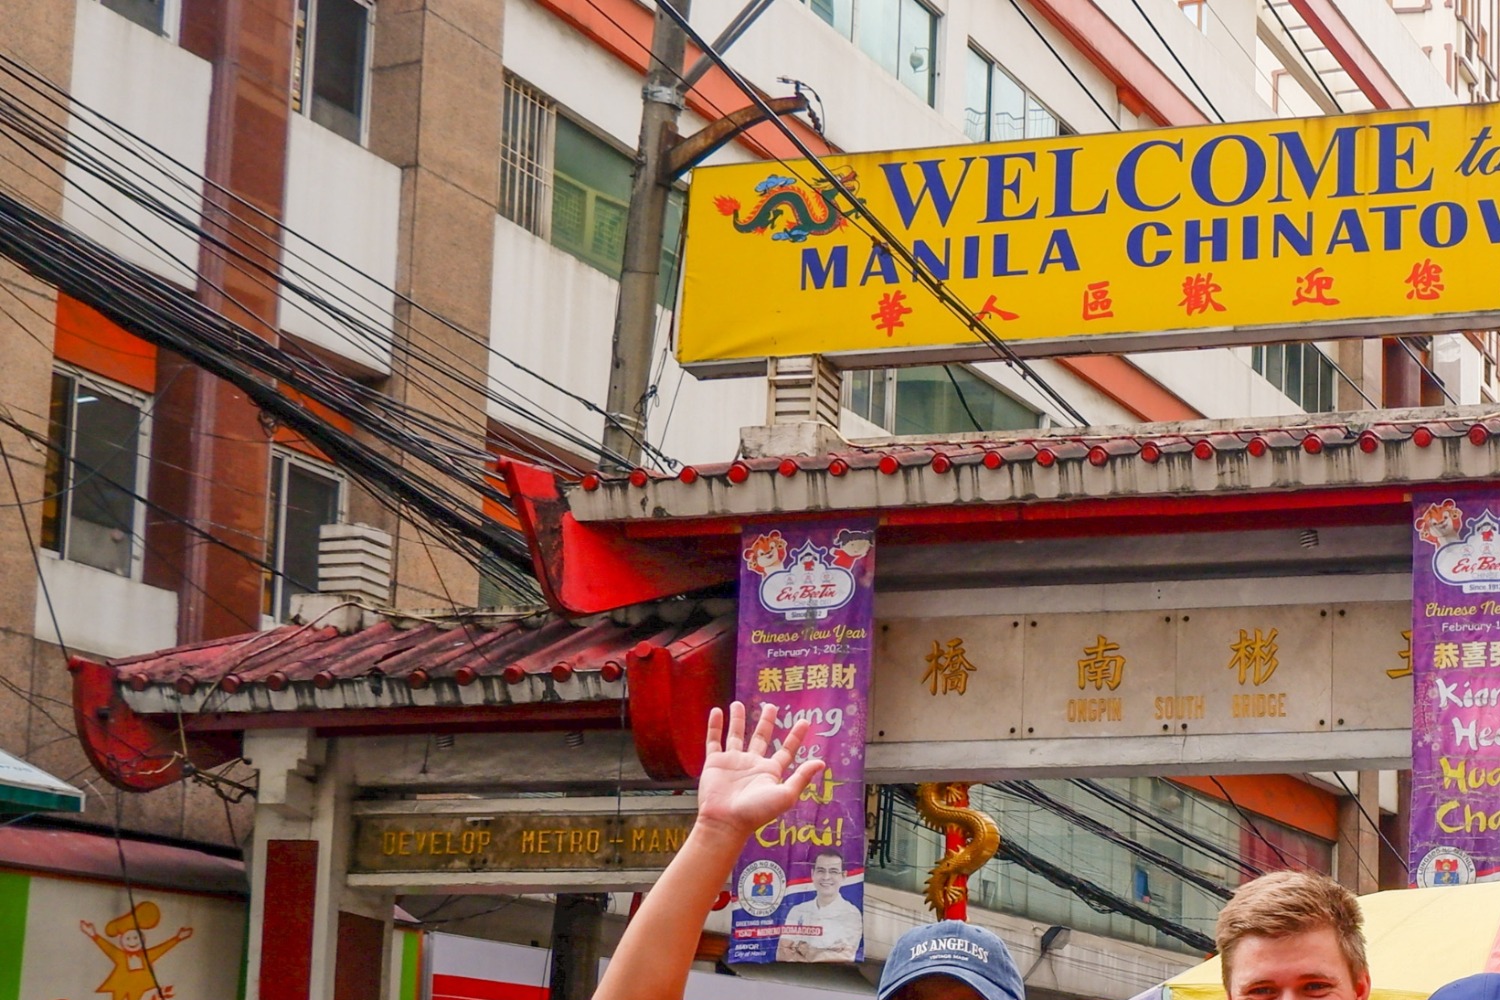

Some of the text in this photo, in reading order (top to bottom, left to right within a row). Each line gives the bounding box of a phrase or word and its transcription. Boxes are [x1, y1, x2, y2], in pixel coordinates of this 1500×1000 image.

[879, 120, 1435, 229] WELCOME
[799, 228, 1079, 291] MANILA
[1425, 602, 1478, 617] Chinese
[751, 629, 800, 644] Chinese
[832, 624, 867, 643] Year
[1441, 622, 1492, 633] February
[767, 647, 811, 658] February
[758, 663, 857, 693] 恭喜發財
[1067, 692, 1288, 723] ONGPIN SOUTH BRIDGE
[383, 829, 493, 856] DEVELOP
[754, 817, 844, 848] Chai!
[909, 940, 928, 961] LOS
